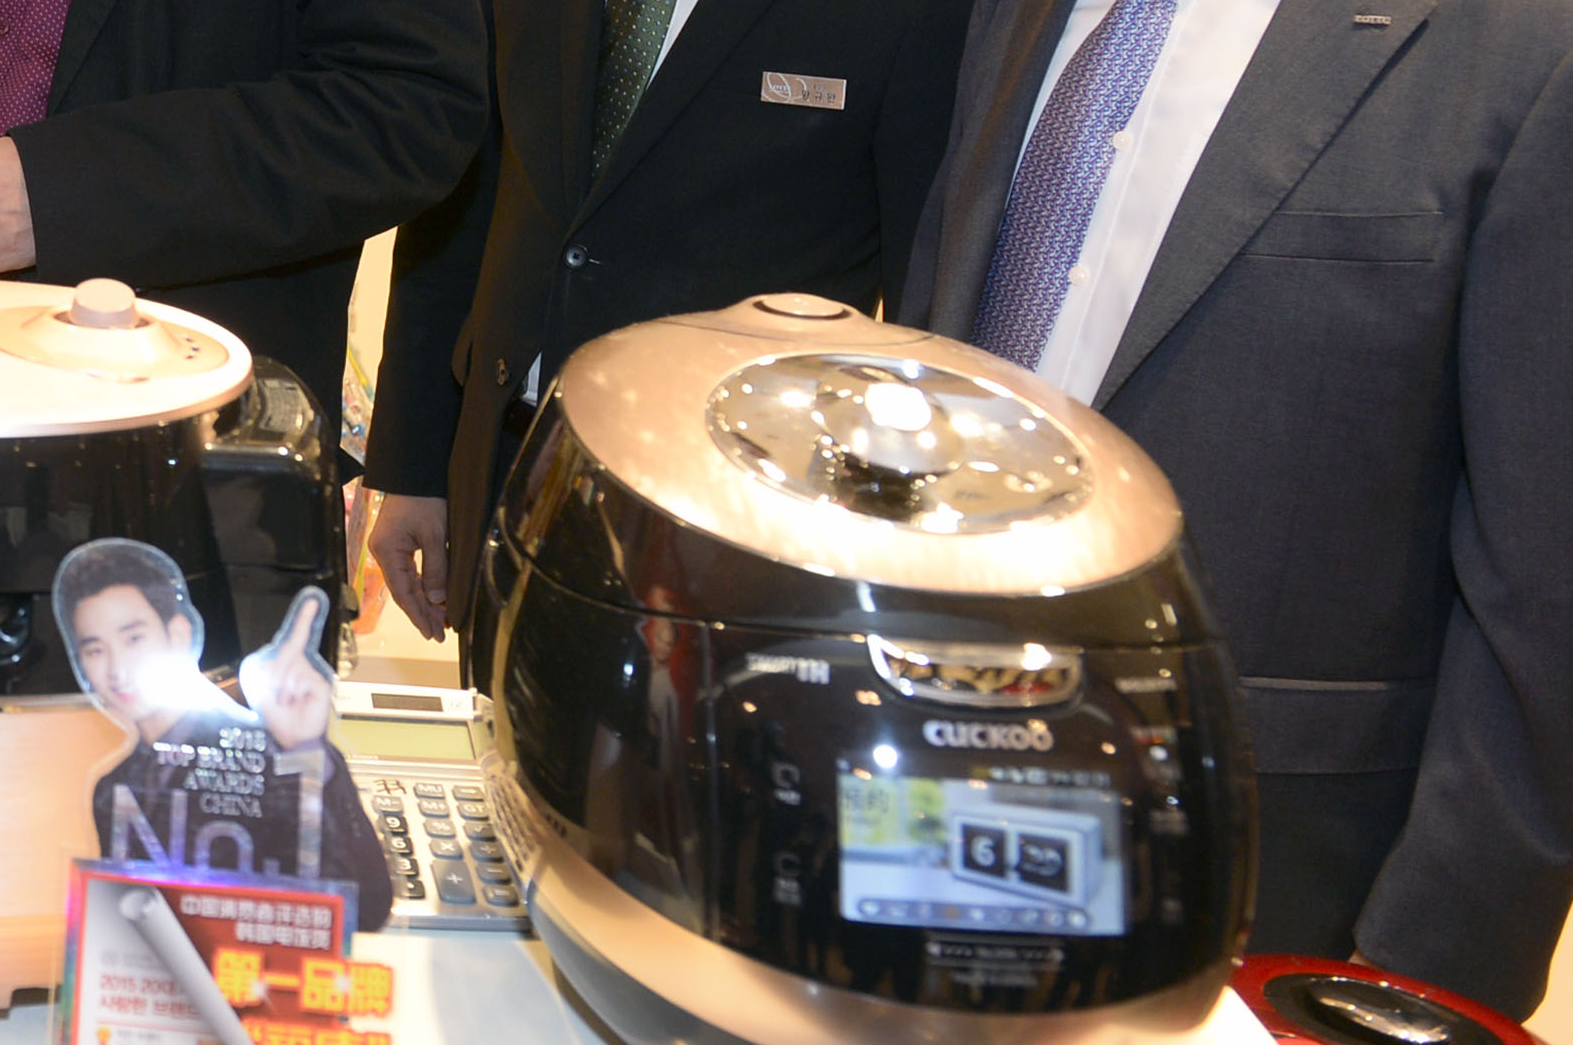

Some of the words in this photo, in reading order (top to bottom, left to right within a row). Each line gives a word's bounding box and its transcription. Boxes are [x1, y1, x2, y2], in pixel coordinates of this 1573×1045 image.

[922, 718, 1054, 753] CUCKOO
[153, 741, 196, 767] TOP
[197, 745, 267, 774] BRAND
[183, 768, 266, 796] AWARDS
[199, 792, 263, 818] CHINA
[385, 815, 401, 829] 9
[392, 837, 407, 850] 6
[397, 859, 412, 872] 3
